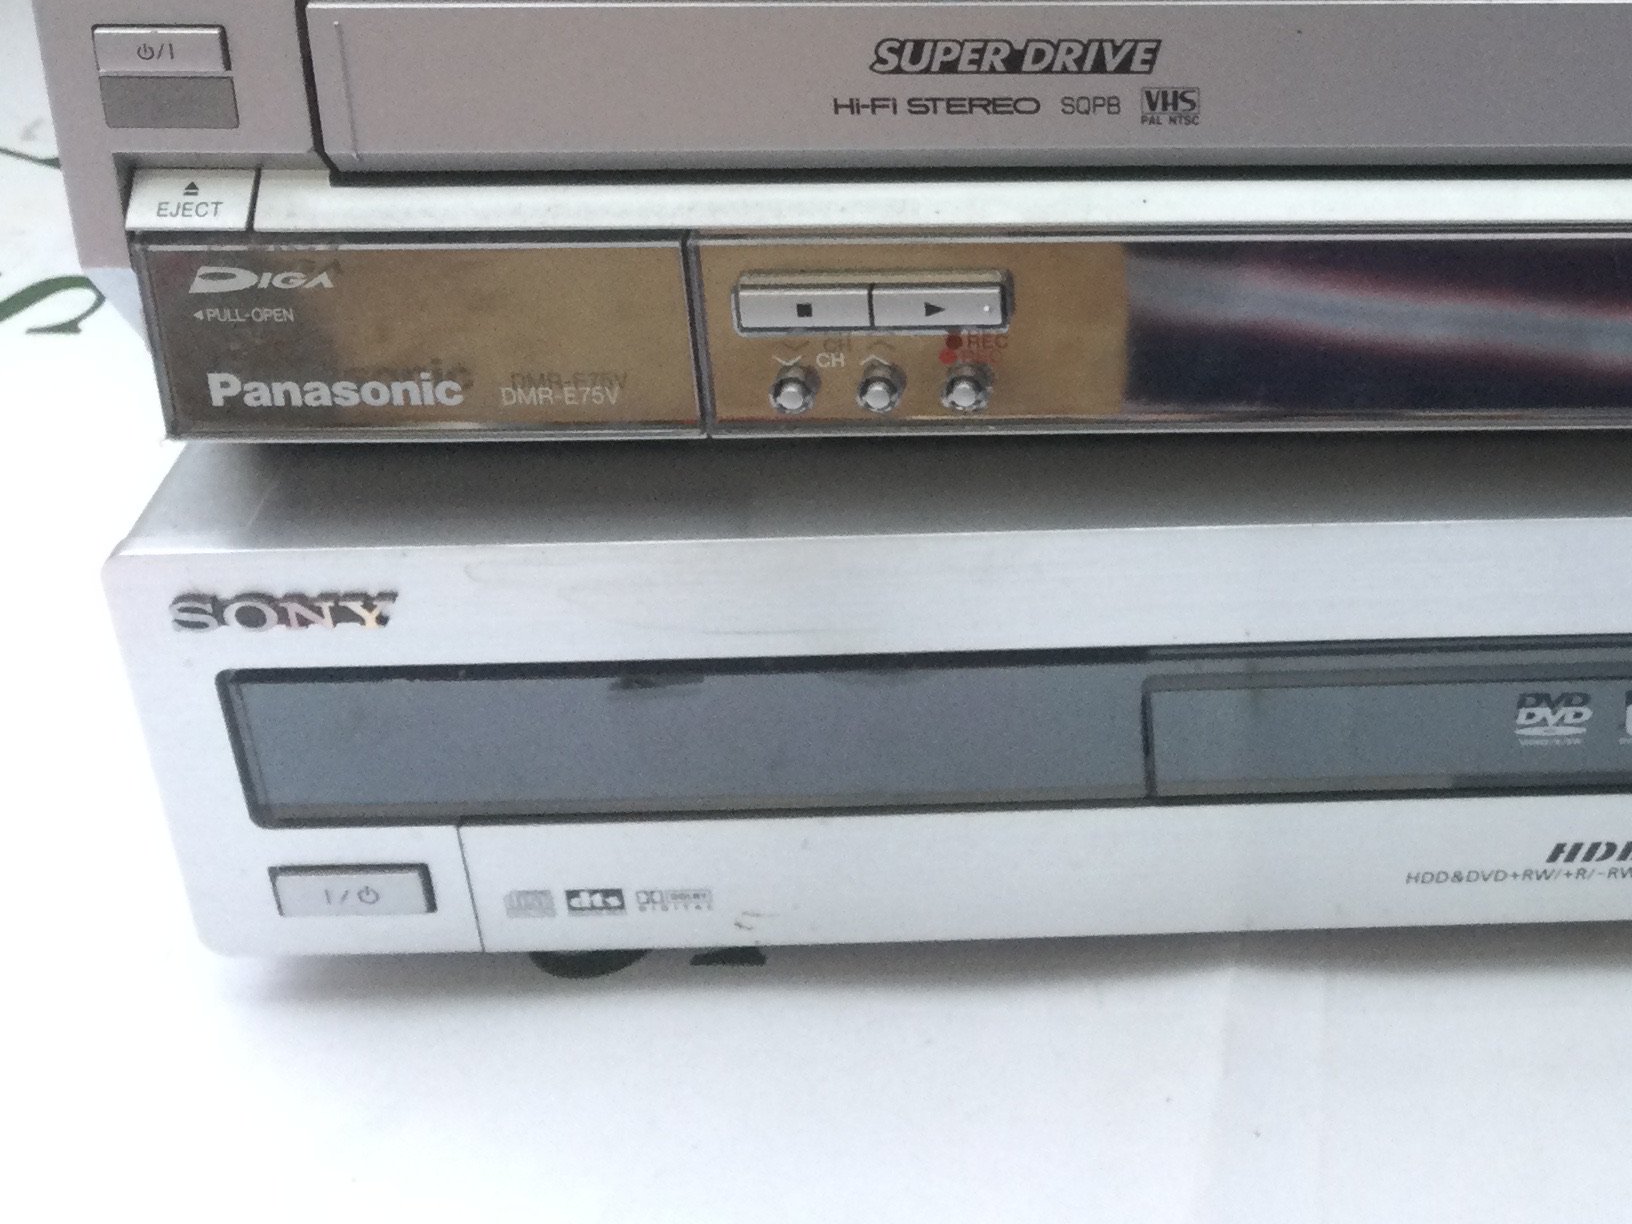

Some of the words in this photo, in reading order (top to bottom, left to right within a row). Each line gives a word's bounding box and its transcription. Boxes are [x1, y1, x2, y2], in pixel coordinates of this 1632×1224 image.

[870, 38, 1013, 74] SUPER
[1020, 38, 1162, 74] DRIVE
[907, 96, 1041, 116] STEREO
[1060, 95, 1122, 116] SQPB
[1144, 89, 1197, 112] VHS
[1141, 115, 1162, 126] PAL
[1169, 115, 1199, 126] NTSC
[156, 201, 223, 218] EJECT
[189, 265, 334, 294] DIGA
[206, 307, 294, 322] PULL-OPEN
[815, 353, 846, 368] CH
[207, 372, 464, 408] Panasonic
[500, 386, 621, 407] DMR-E75V
[169, 591, 398, 632] SONY
[1515, 706, 1593, 726] DVD
